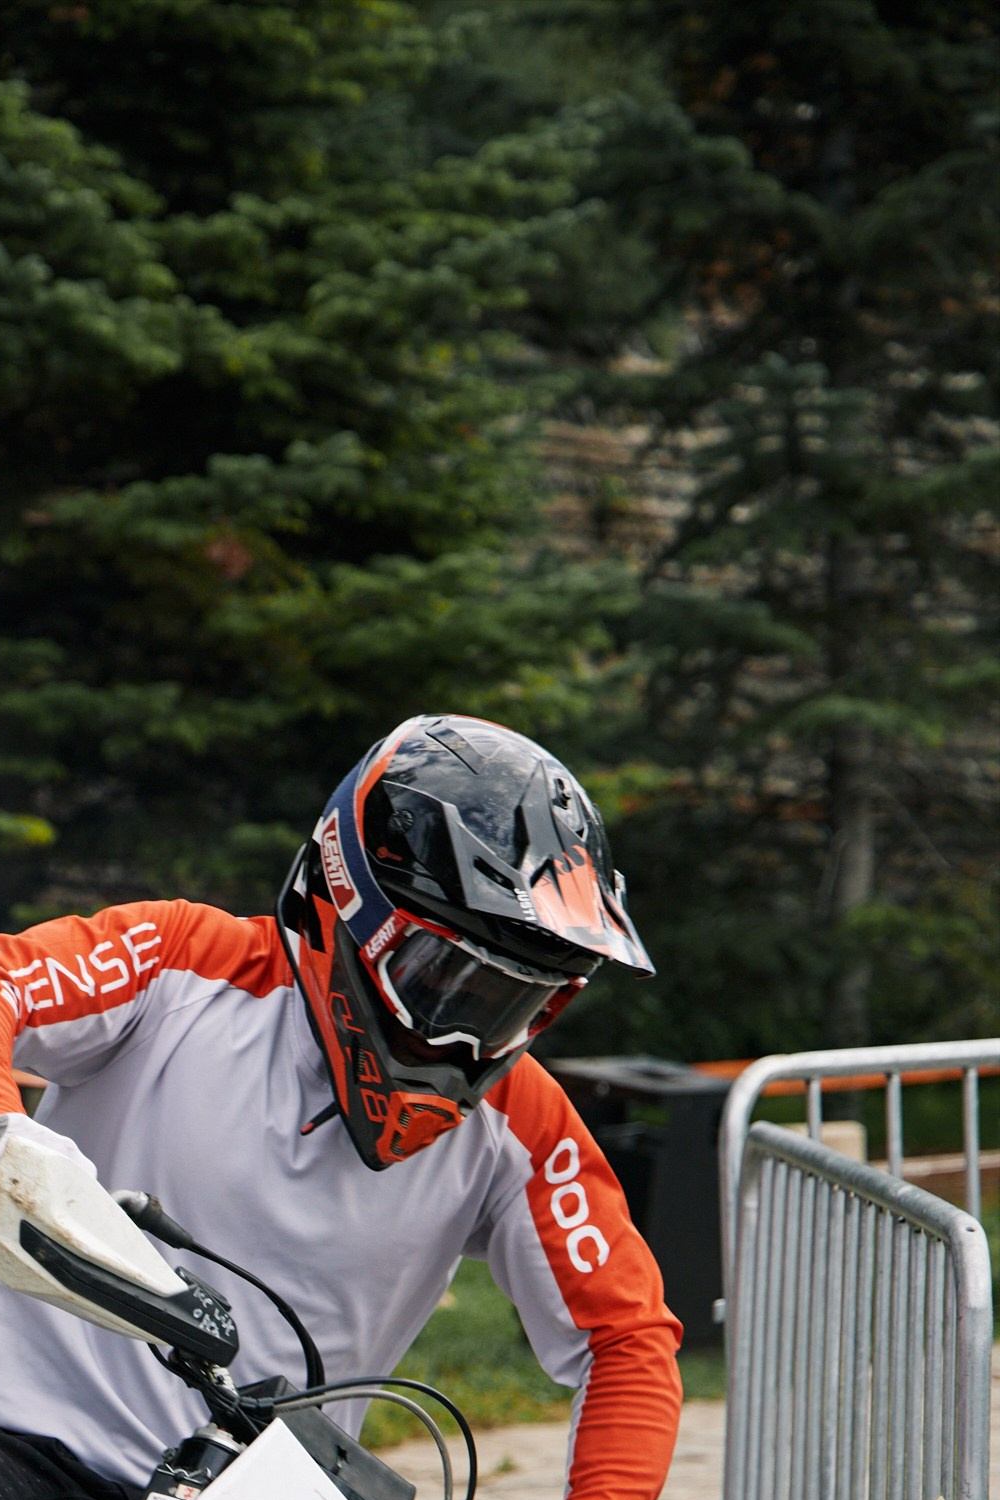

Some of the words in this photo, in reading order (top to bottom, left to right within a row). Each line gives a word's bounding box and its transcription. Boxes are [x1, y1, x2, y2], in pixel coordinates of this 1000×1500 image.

[322, 829, 351, 890] LEATT
[513, 887, 537, 921] JUST1
[365, 915, 397, 960] LEATT
